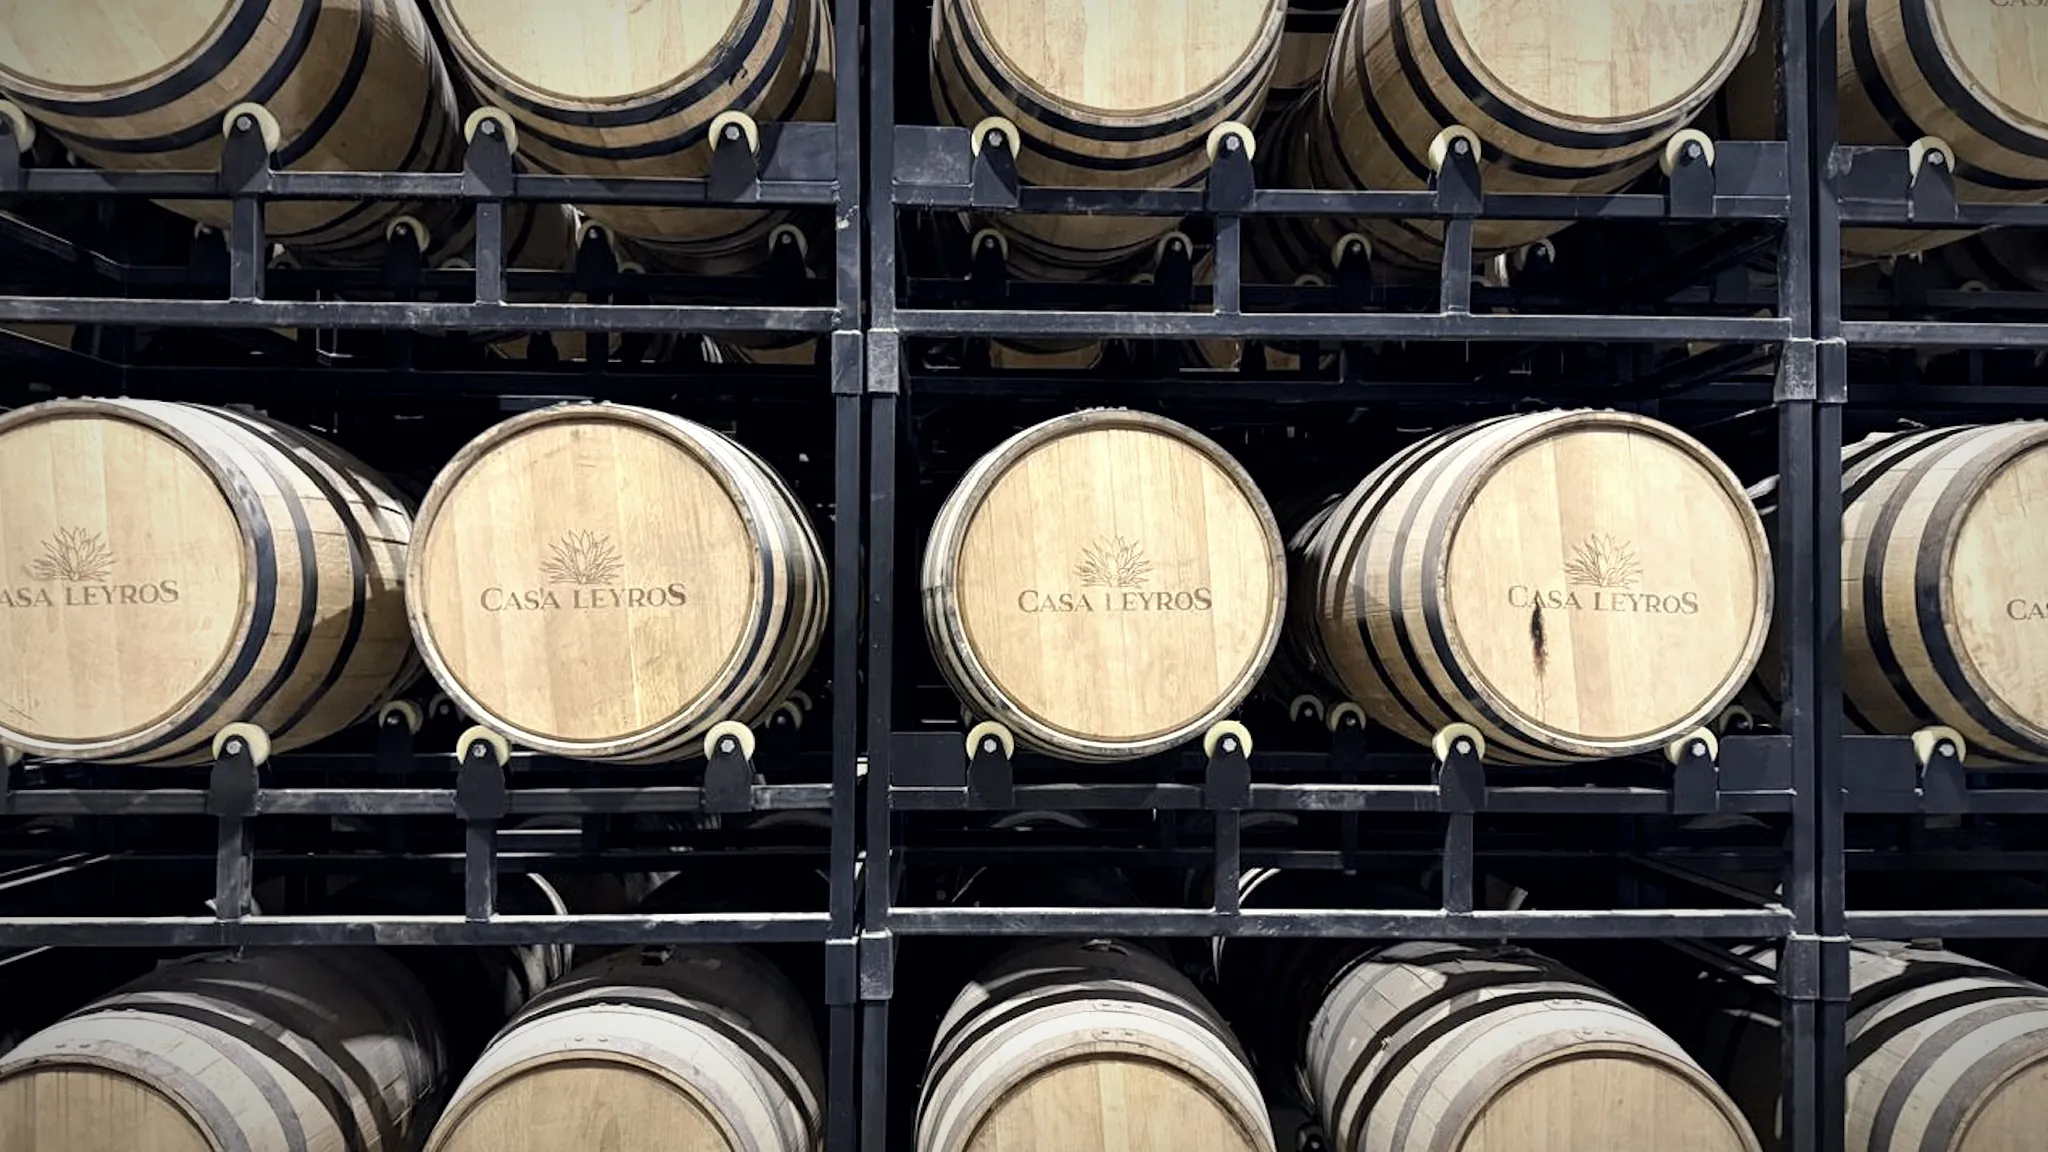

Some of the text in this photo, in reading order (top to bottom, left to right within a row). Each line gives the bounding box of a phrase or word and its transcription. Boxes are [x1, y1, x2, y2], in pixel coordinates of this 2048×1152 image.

[66, 579, 179, 606] LEYROS
[480, 583, 687, 612] CASA LEYROS
[1018, 587, 1212, 613] CASA LEYROS
[1507, 585, 1699, 614] CASA LEYROS
[2006, 598, 2048, 620] CA
